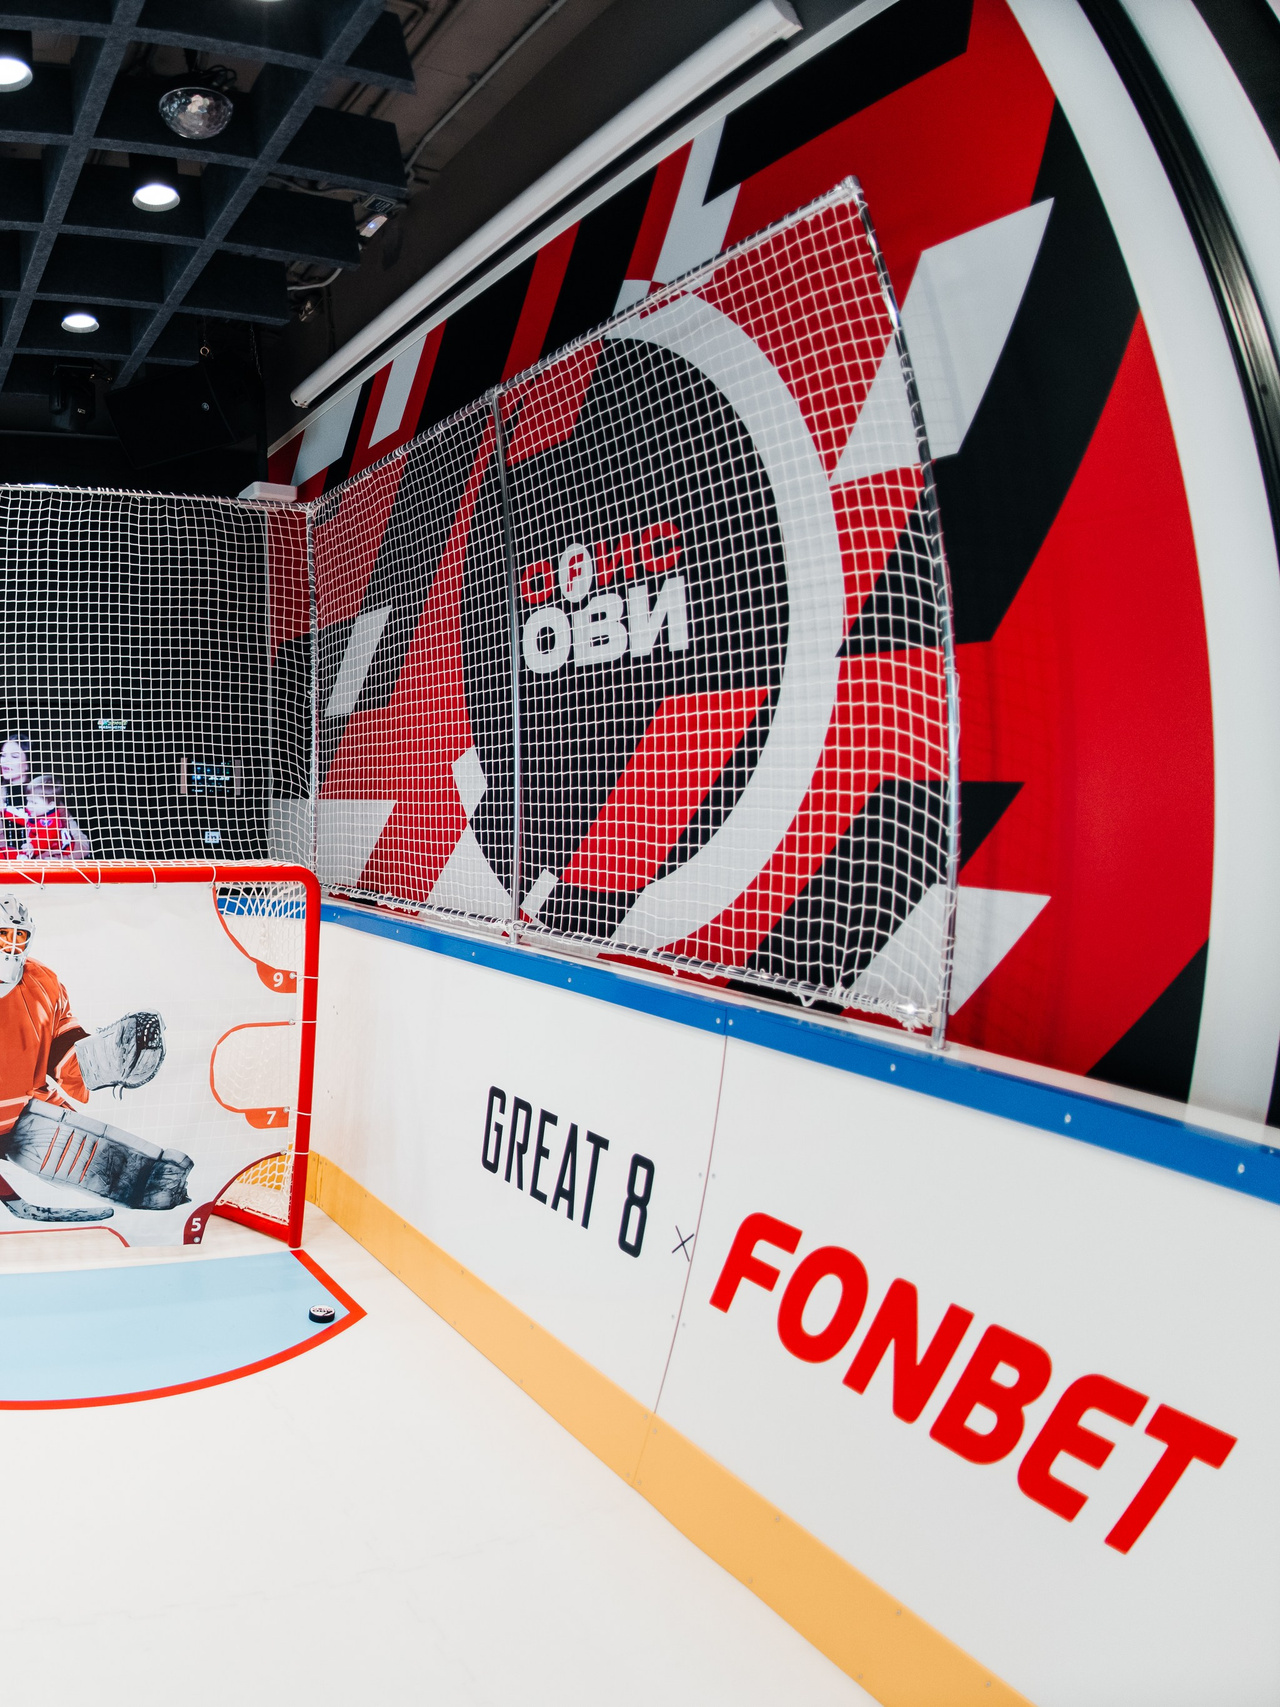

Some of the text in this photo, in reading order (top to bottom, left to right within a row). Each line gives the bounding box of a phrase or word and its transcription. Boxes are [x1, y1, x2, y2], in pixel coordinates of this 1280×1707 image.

[522, 576, 689, 674] ОВИ
[273, 972, 284, 988] 9
[266, 1110, 277, 1126] 7
[191, 1217, 202, 1232] 5
[481, 1085, 610, 1230] GREAT
[618, 1153, 655, 1259] 8
[709, 1212, 1237, 1554] FONBET
